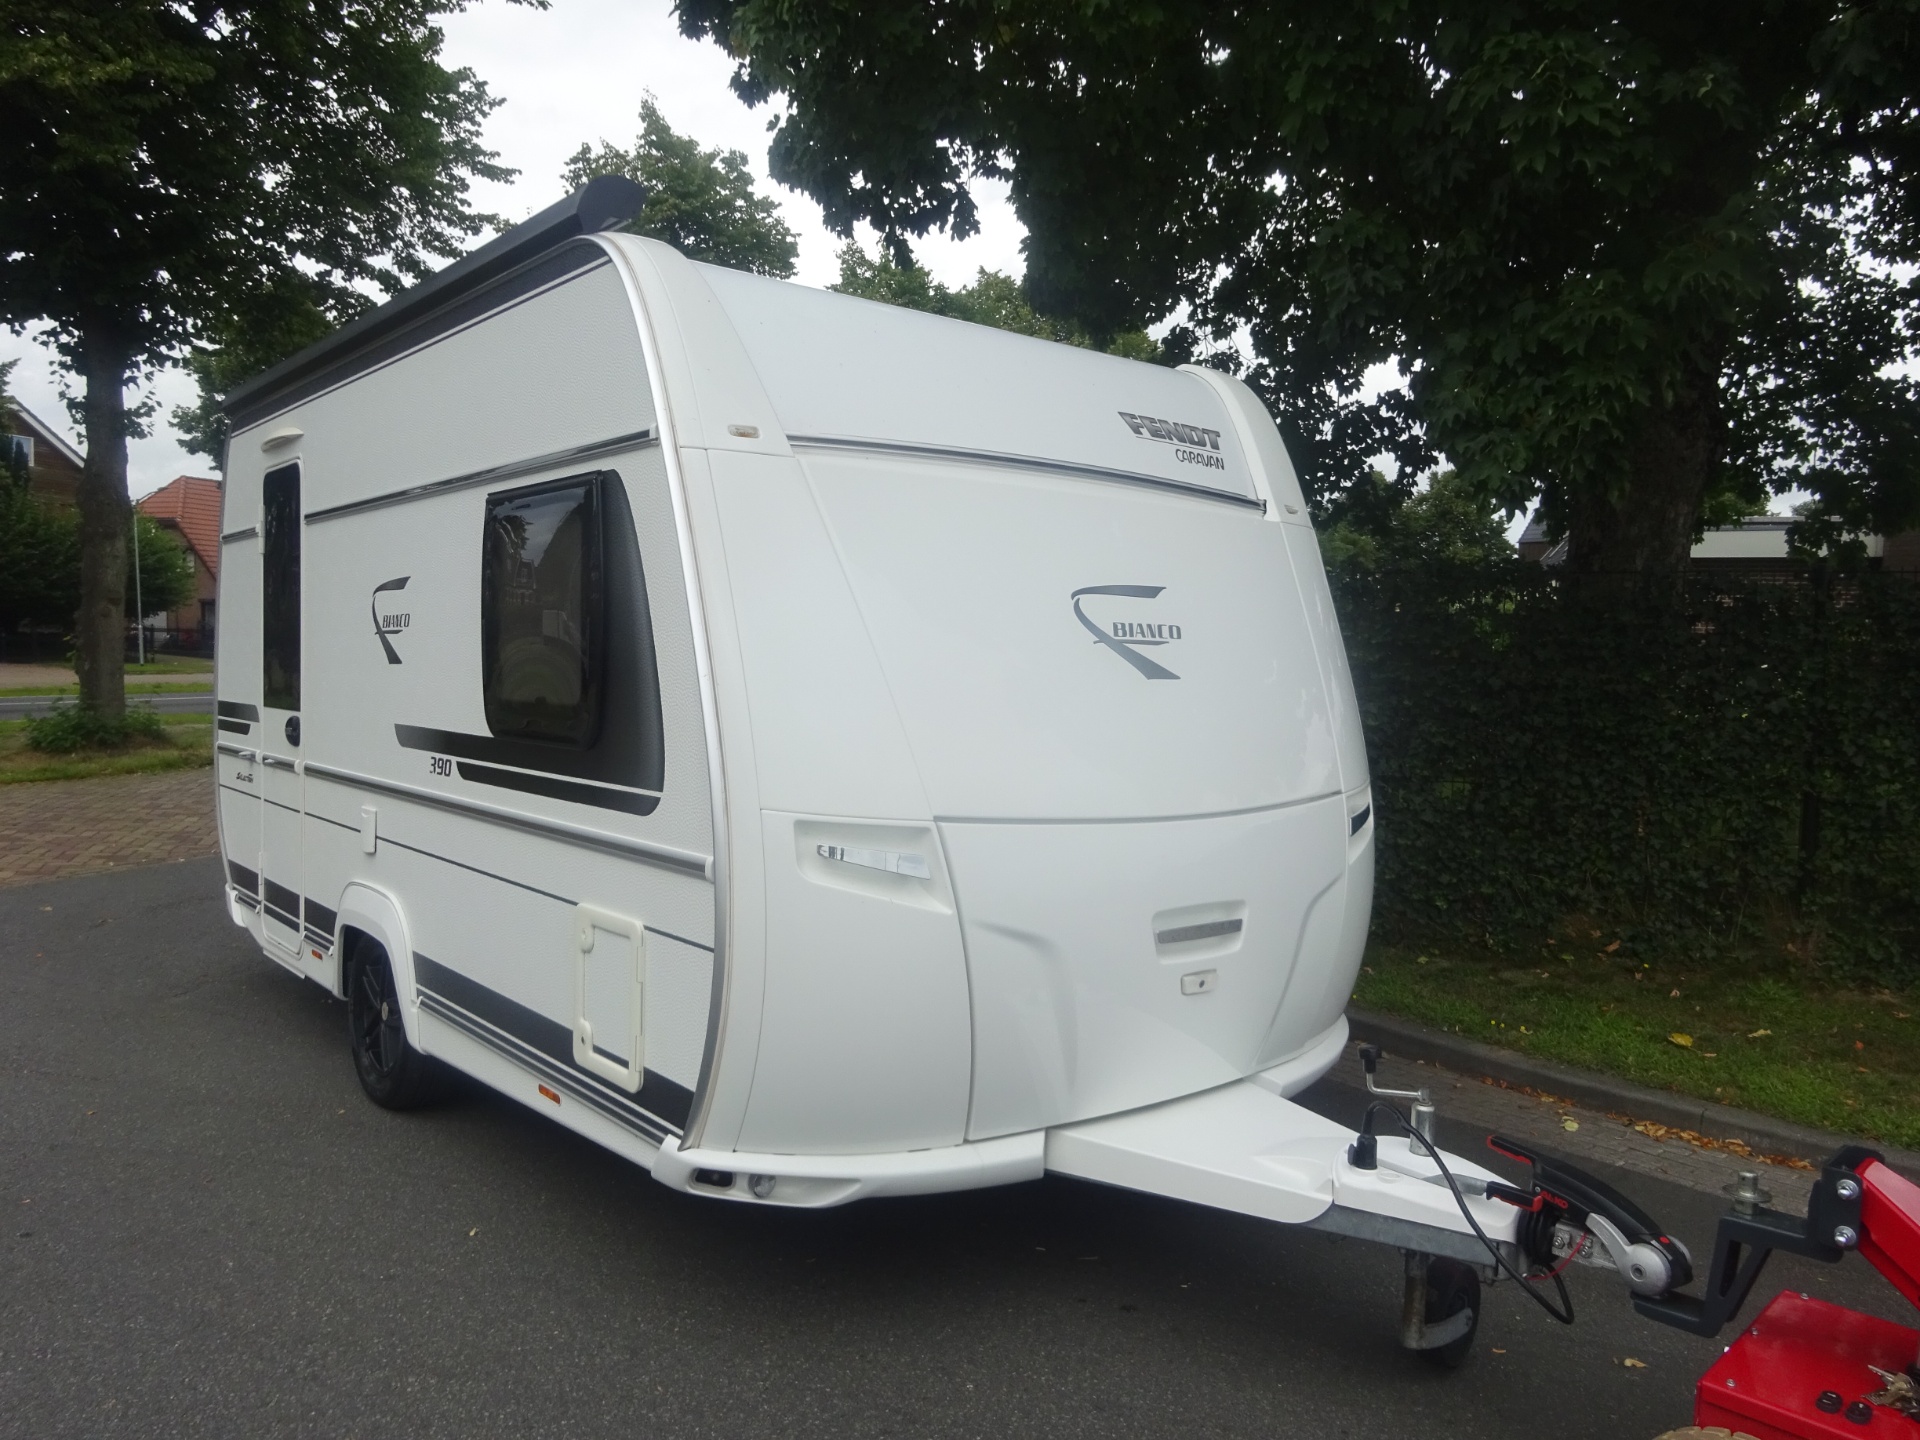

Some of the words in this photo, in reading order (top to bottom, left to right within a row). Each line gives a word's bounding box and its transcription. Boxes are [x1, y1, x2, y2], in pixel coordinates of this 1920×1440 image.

[1117, 411, 1221, 451] FENDT
[1175, 448, 1225, 471] CARAVAN
[382, 613, 410, 628] BIANCO
[1112, 621, 1182, 640] BIANCO
[429, 756, 452, 777] 390
